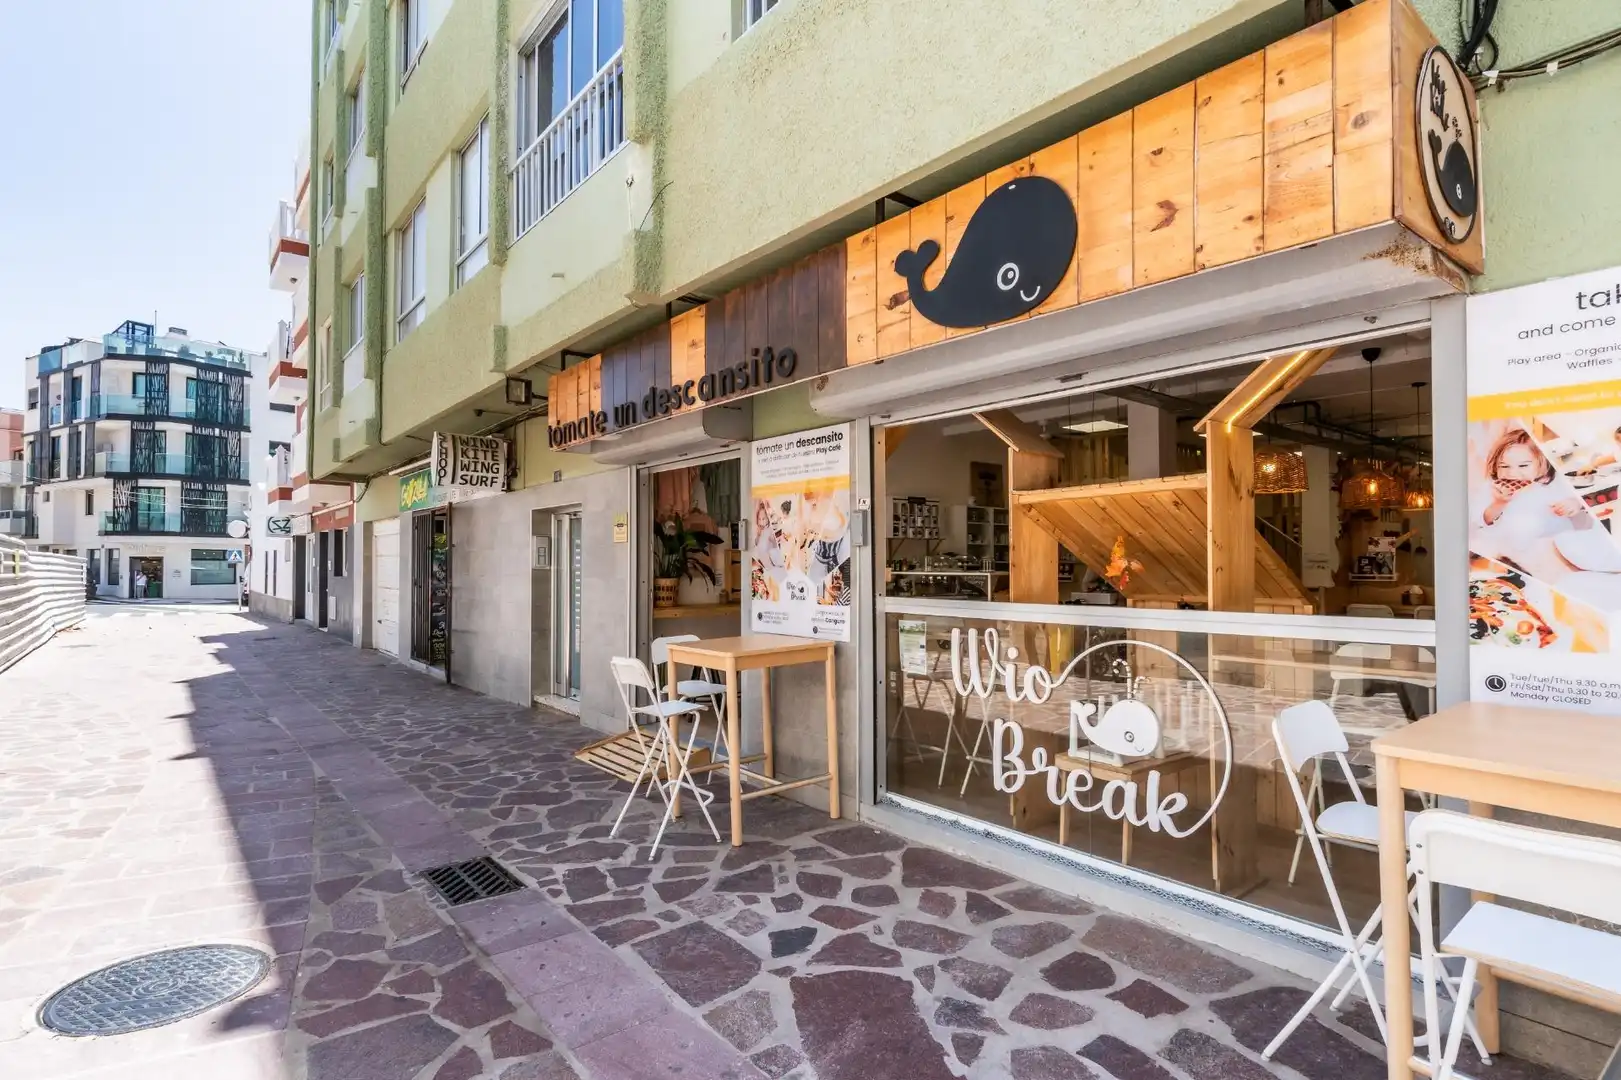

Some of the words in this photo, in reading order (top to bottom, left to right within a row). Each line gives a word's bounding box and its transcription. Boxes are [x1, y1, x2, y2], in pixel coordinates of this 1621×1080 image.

[1518, 324, 1554, 340] and
[1559, 316, 1616, 333] come
[1507, 358, 1531, 366] Play
[1534, 352, 1562, 363] area
[1566, 357, 1613, 370] Waffles
[547, 409, 608, 448] tómate
[614, 400, 637, 429] un
[642, 346, 797, 420] descansito
[459, 436, 499, 449] WIND
[784, 441, 795, 450] un
[796, 431, 844, 448] descansito
[460, 448, 499, 462] KITE
[816, 447, 827, 455] Play
[438, 432, 448, 487] SCHOOL
[460, 460, 500, 474] WING
[459, 474, 499, 487] SURF
[950, 627, 1053, 704] Wio
[1510, 691, 1549, 702] Monday
[1552, 695, 1592, 705] CLOSED
[1591, 690, 1602, 698] to
[1604, 691, 1621, 700] 20.
[993, 718, 1189, 839] Break
